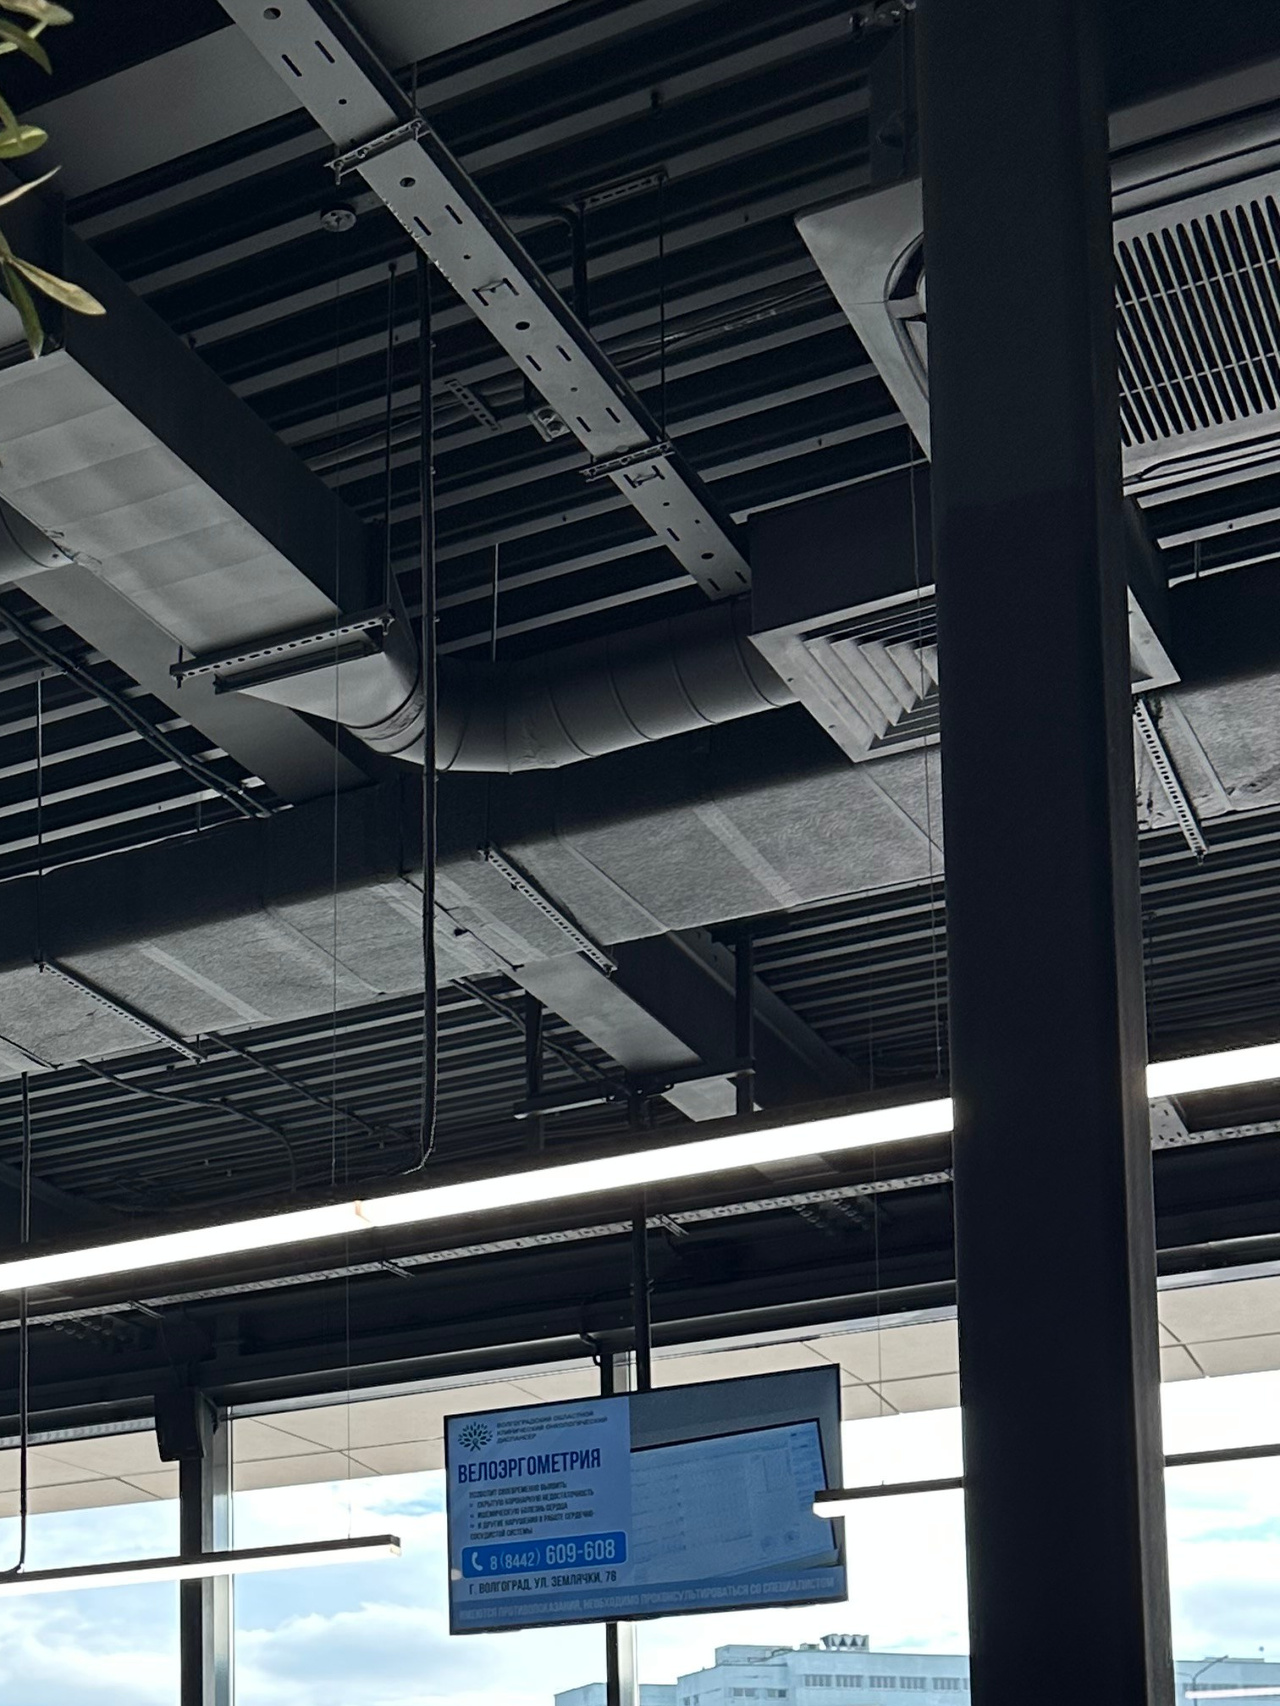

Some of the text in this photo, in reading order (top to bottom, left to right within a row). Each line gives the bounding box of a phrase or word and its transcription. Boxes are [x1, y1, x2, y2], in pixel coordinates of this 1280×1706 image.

[458, 1448, 601, 1484] ВЕЛОЭРГОМЕТРИЯ
[490, 1539, 616, 1571] 8 (8442) 609-608
